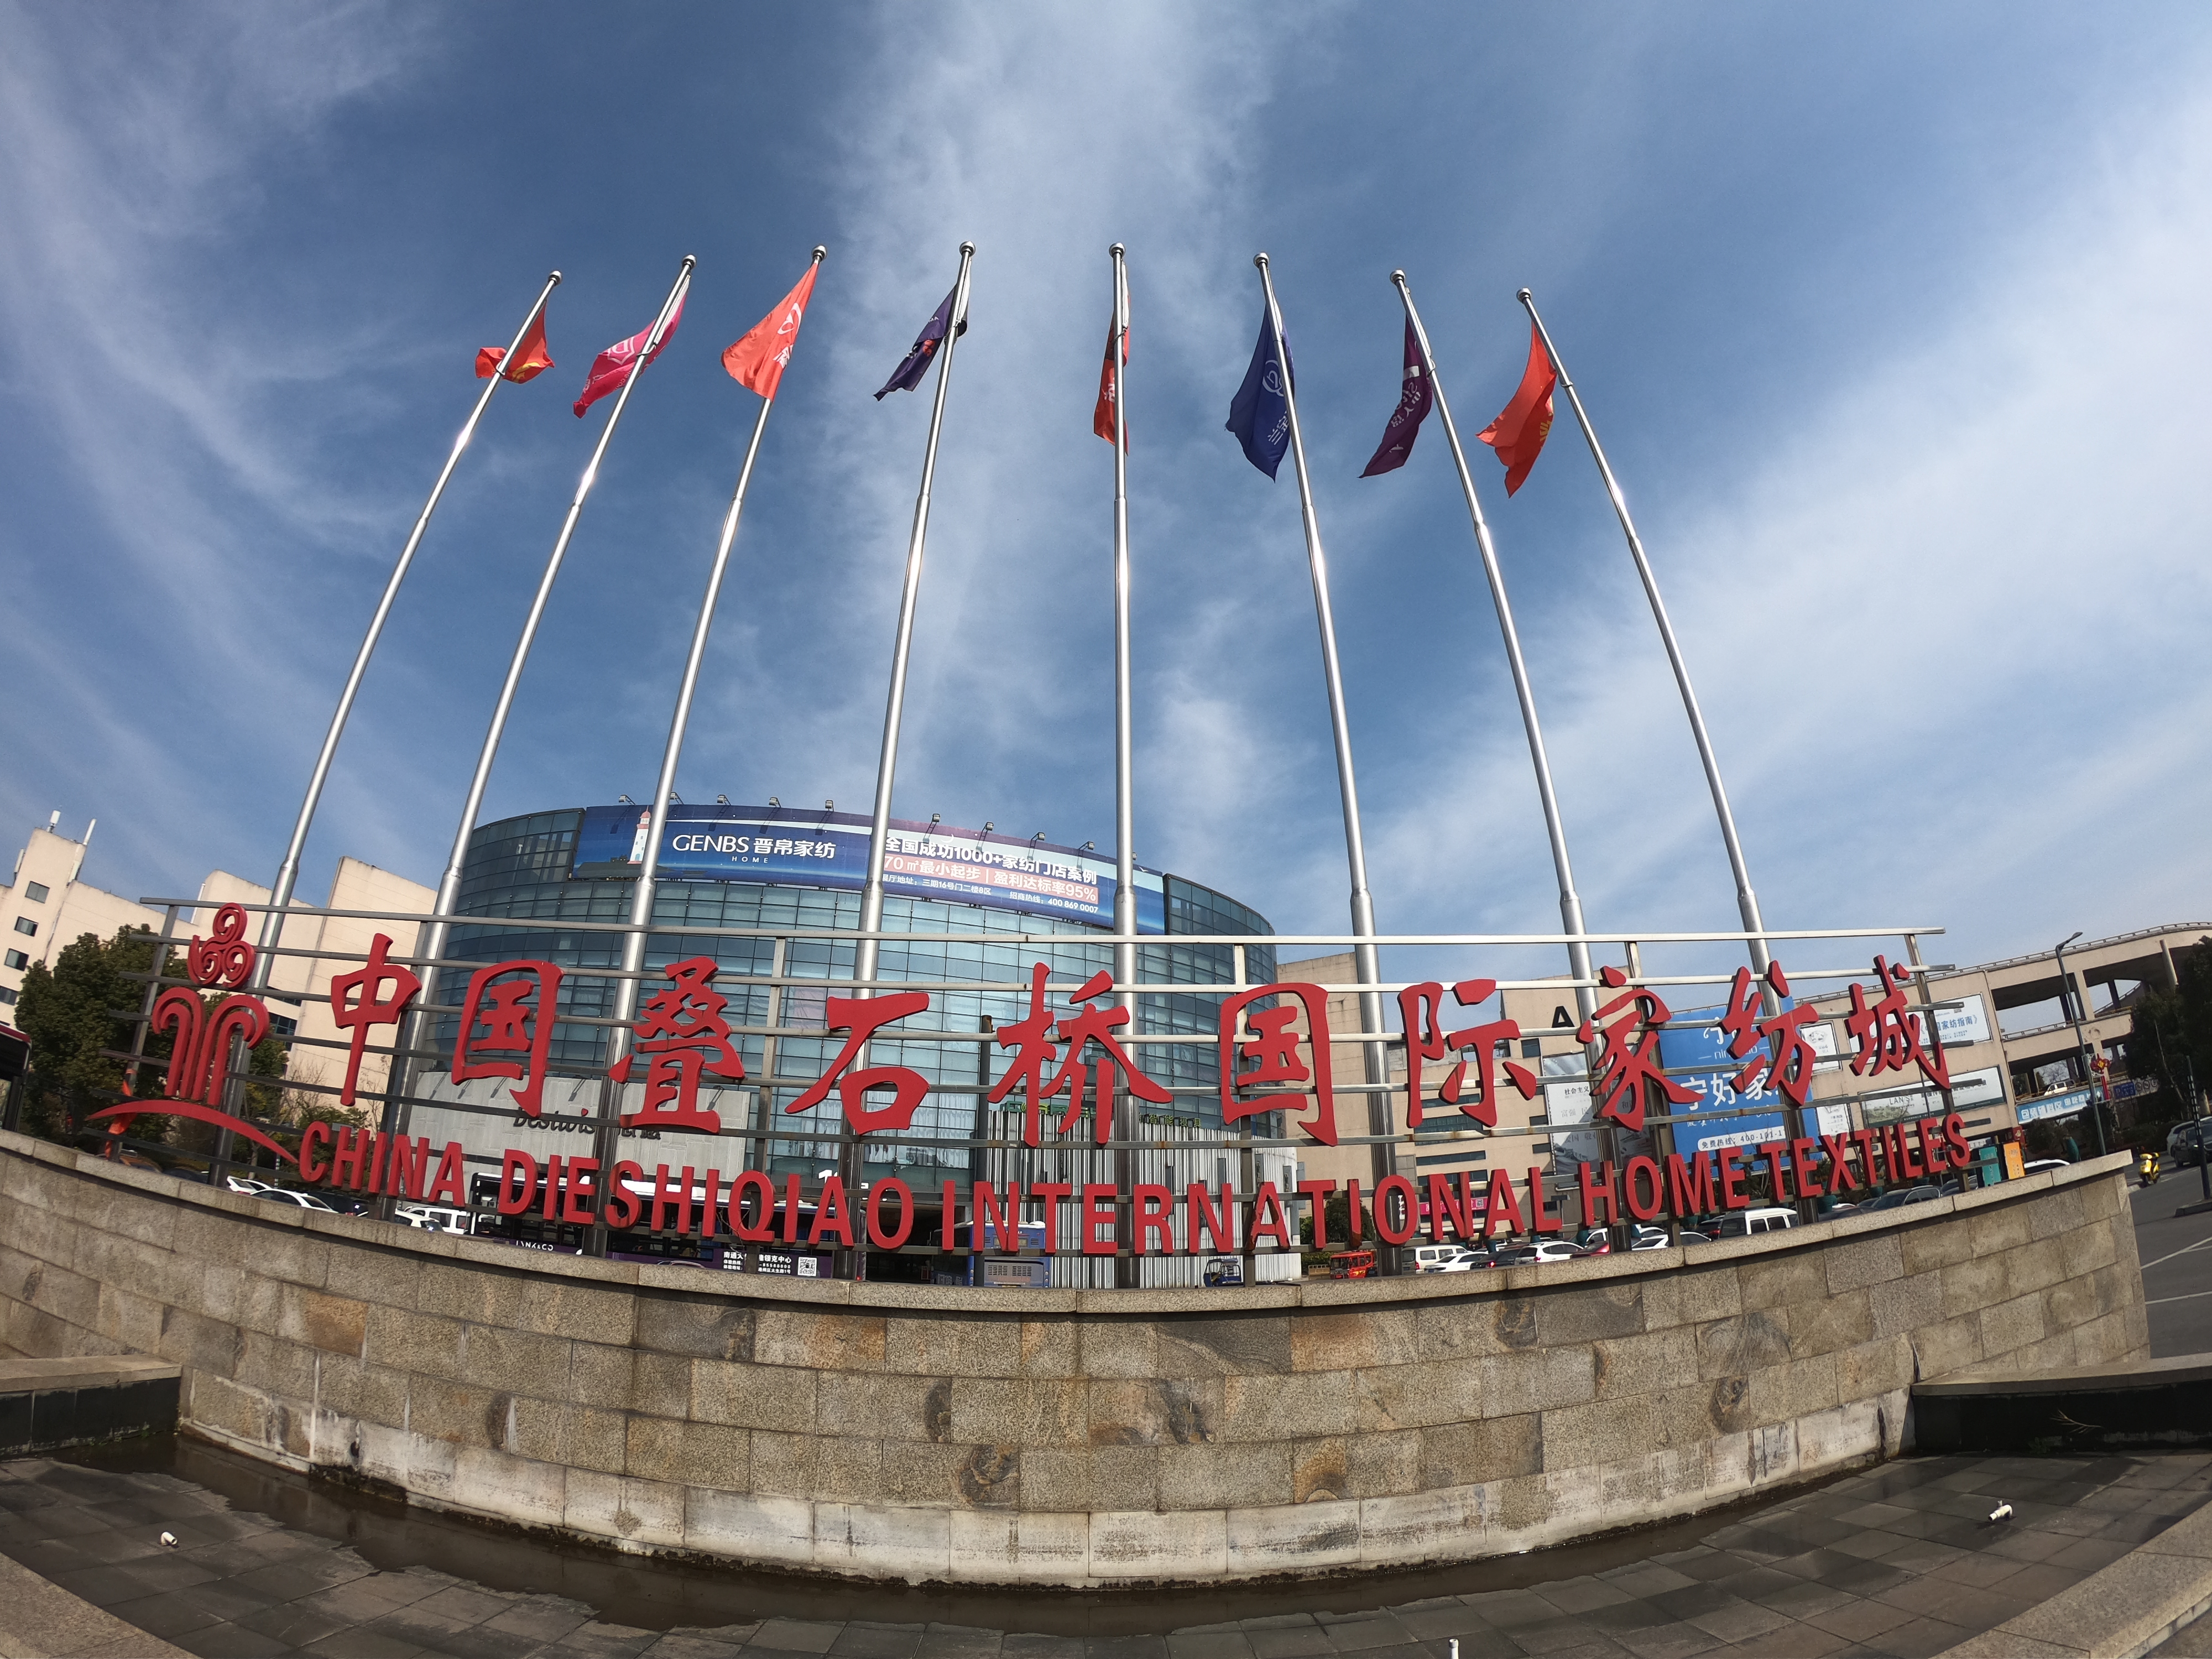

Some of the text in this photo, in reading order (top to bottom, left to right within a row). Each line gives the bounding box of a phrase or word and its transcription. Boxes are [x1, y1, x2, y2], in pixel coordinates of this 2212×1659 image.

[672, 834, 749, 853] GENBS
[753, 837, 836, 858] 晋帛家纺
[994, 870, 1097, 902] 盈利达标率95%
[1065, 901, 1078, 909] 869
[1079, 904, 1099, 914] 0007
[1551, 1005, 1575, 1028] A
[299, 1113, 1971, 1254] CHINA DIESHIQIAO INTERNATIONAL HOME TEXTILES
